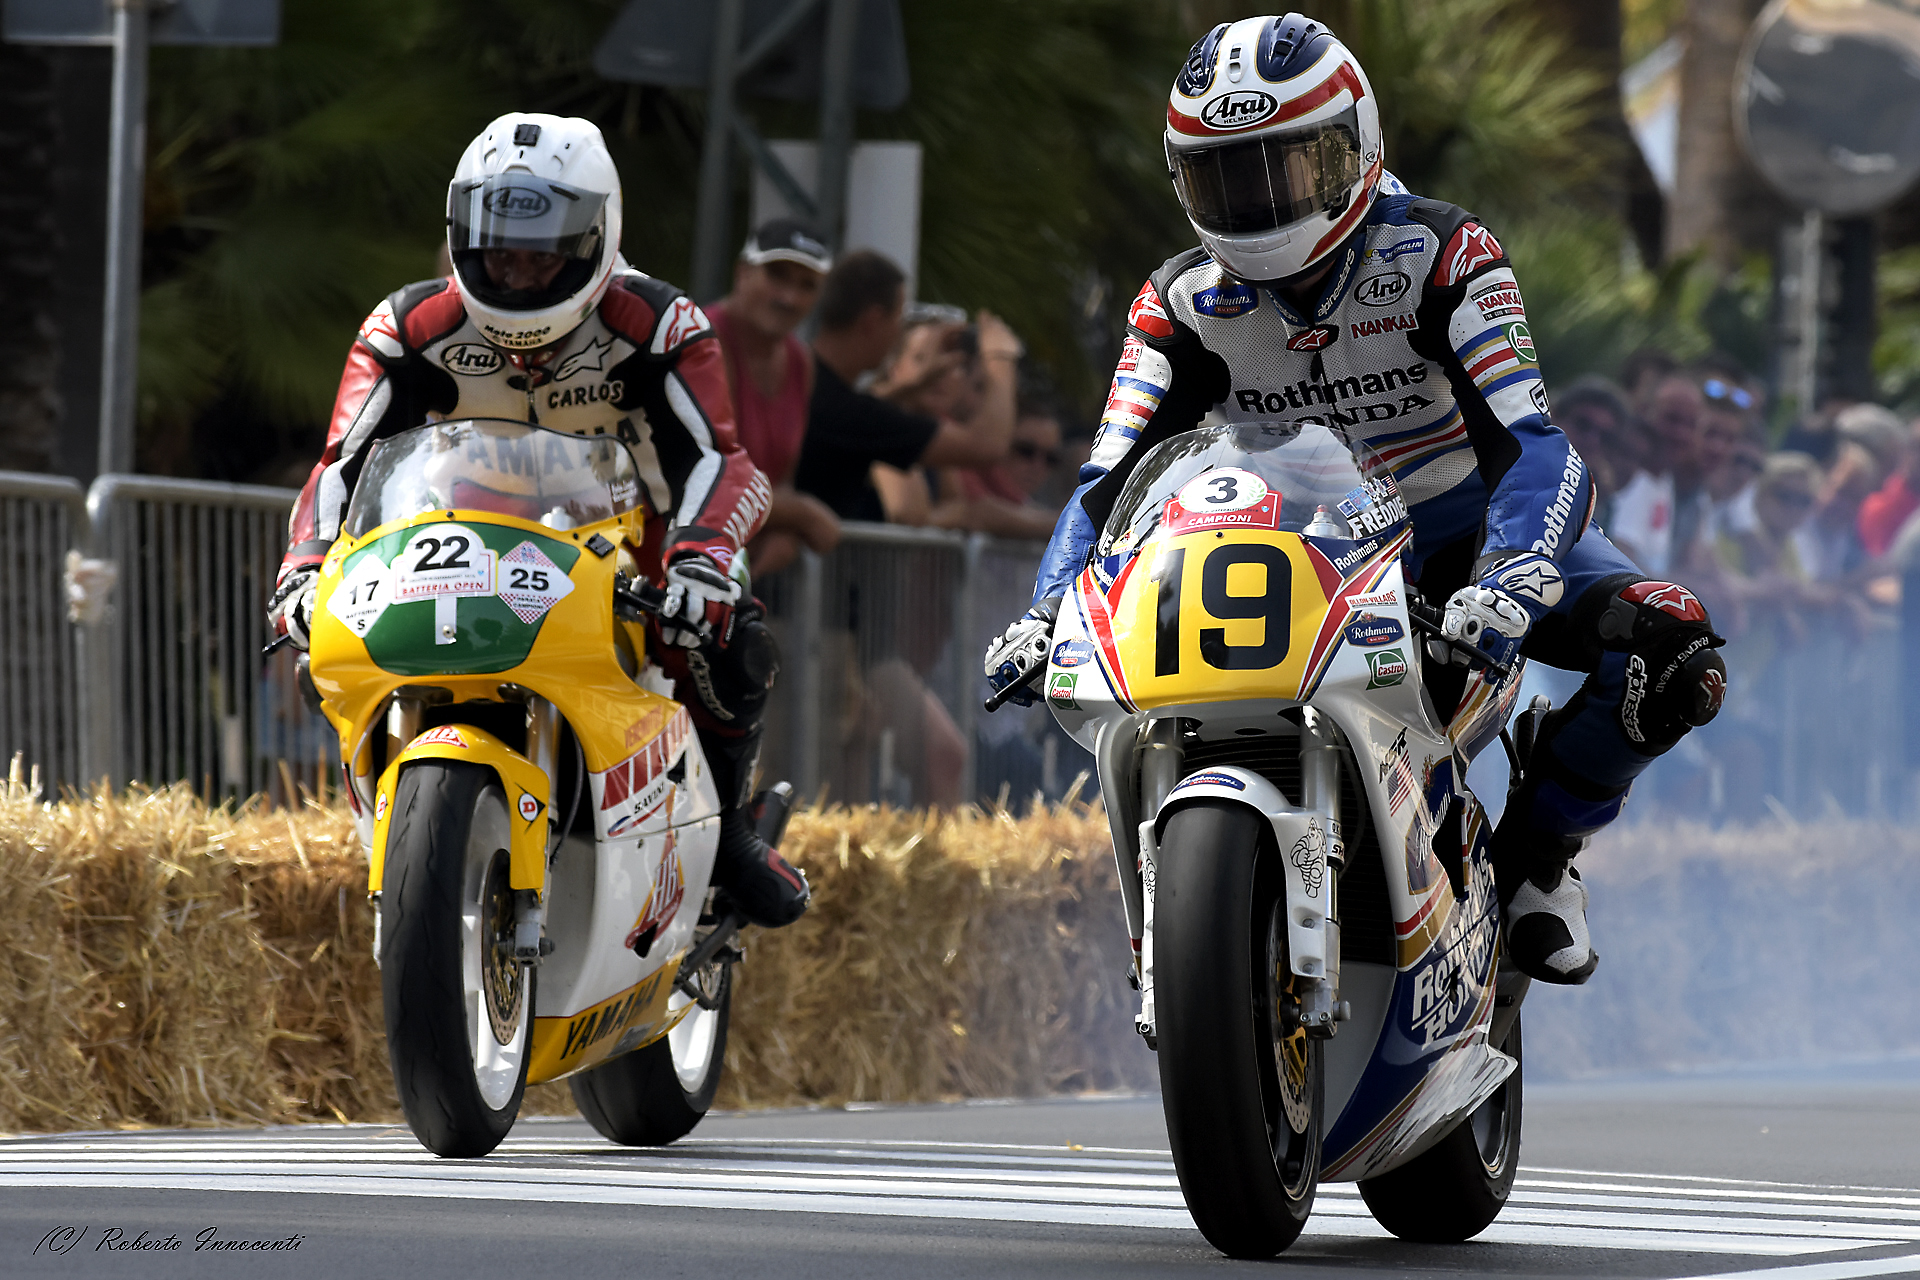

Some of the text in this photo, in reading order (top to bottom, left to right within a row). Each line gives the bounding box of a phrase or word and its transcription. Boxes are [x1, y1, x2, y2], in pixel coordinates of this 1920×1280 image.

[1206, 93, 1268, 122] Arai
[495, 187, 542, 211] Arai
[1317, 248, 1355, 317] alpinestars
[1199, 294, 1252, 308] Rothmans
[484, 324, 513, 338] Moto
[515, 326, 551, 339] 2000
[445, 346, 498, 368] Arai
[548, 381, 622, 409] CARLOS
[1235, 362, 1428, 415] Rothmans
[1204, 476, 1238, 504] 3
[1531, 443, 1582, 559] Rothmans
[1187, 514, 1252, 526] CAMPIONI
[1346, 495, 1407, 539] FREDDIE
[413, 535, 470, 573] 22
[1333, 539, 1379, 571] Rothmans
[349, 580, 380, 606] 17
[402, 582, 484, 595] BATTERIA OPEN
[510, 568, 550, 592] 25
[1150, 543, 1293, 678] 19
[1351, 625, 1399, 639] Rothmans
[1377, 663, 1405, 676] Castrol
[1655, 636, 1709, 693] RACING AHEAD
[1052, 688, 1072, 698] Castrol
[522, 801, 536, 814] D
[560, 971, 663, 1061] YAMAHA
